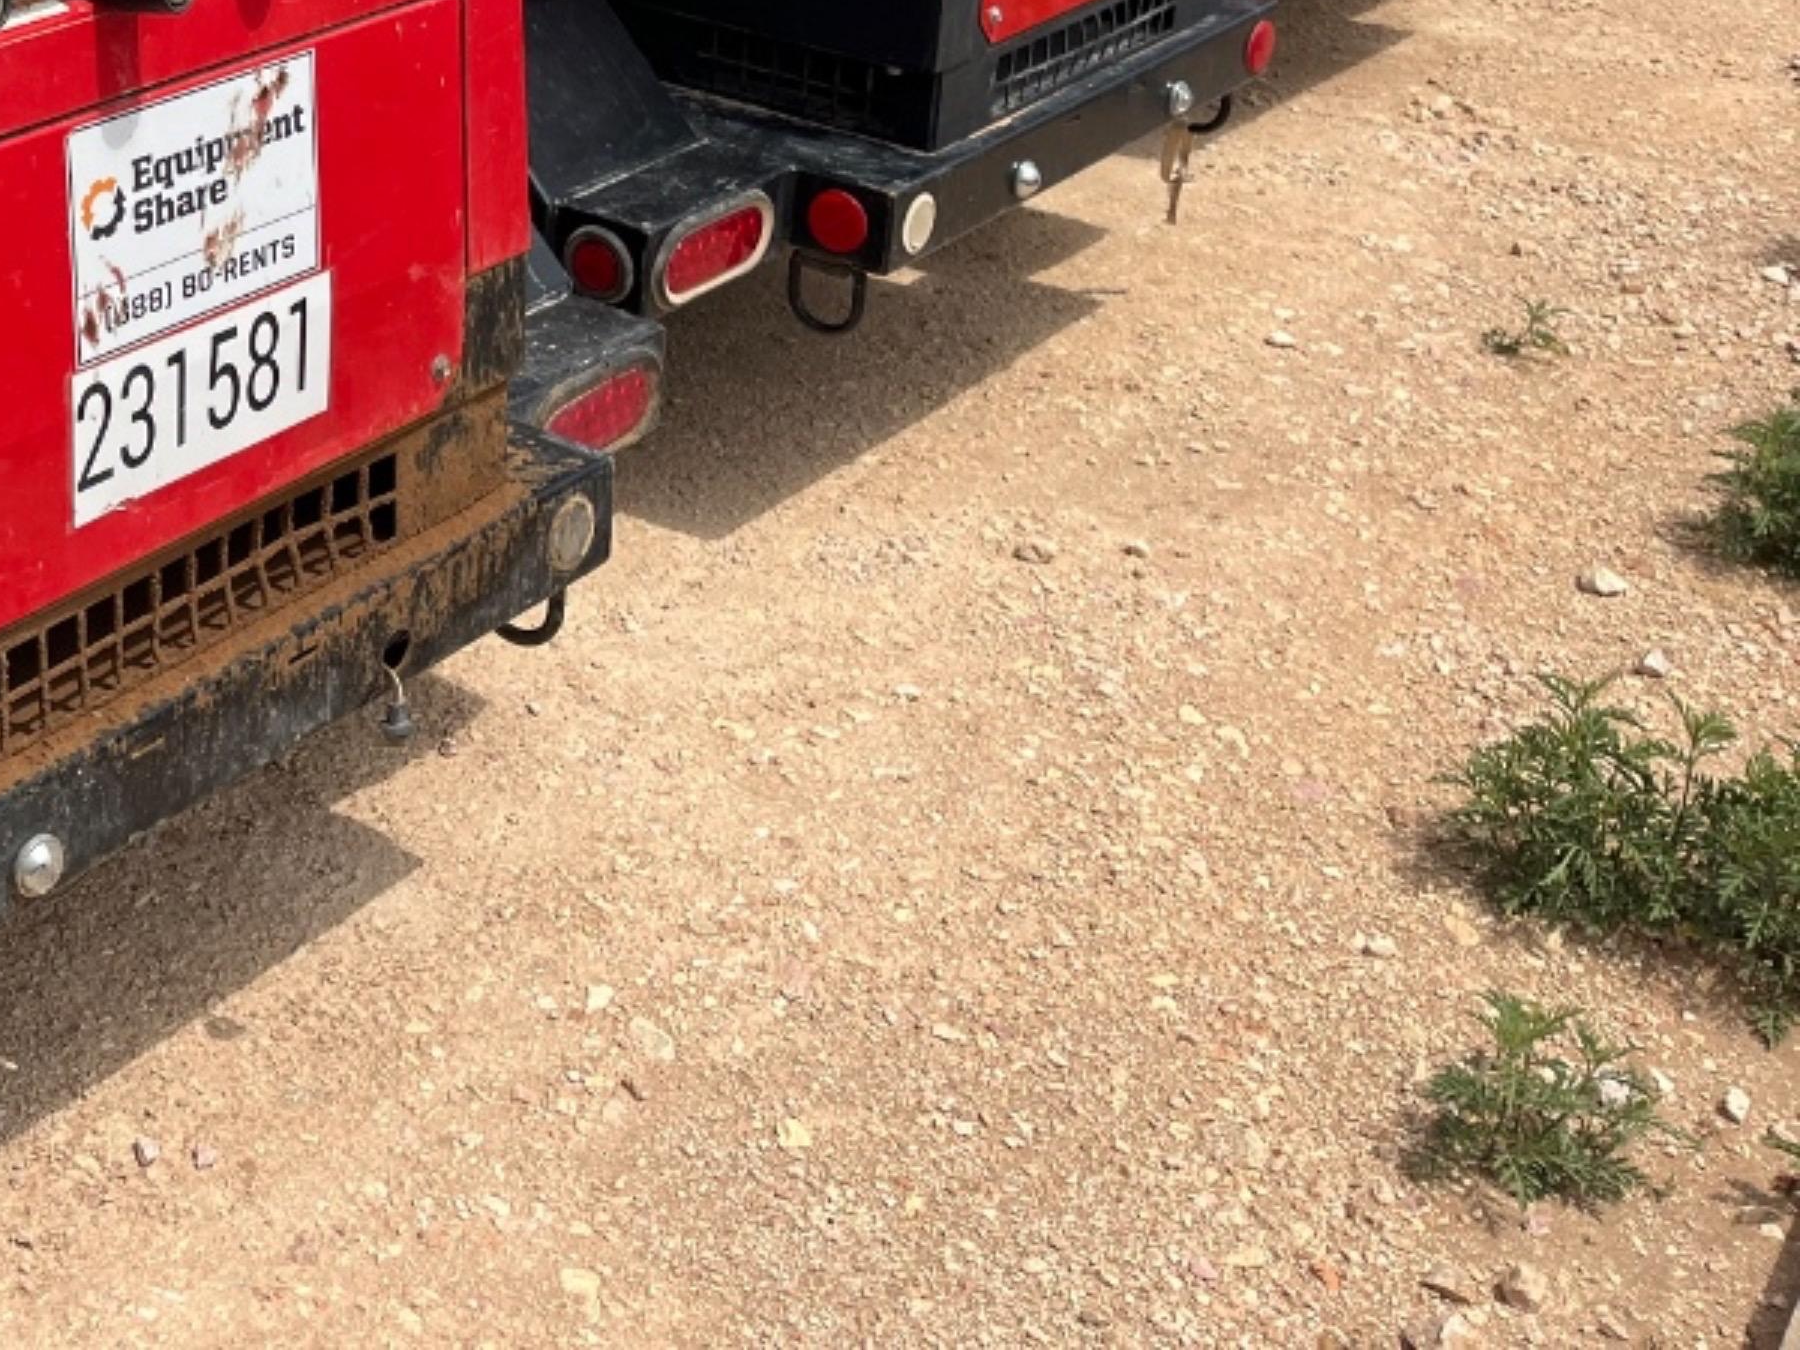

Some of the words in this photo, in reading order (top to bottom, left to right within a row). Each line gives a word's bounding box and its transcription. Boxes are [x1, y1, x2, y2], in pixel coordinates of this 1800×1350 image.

[133, 178, 228, 234] Share
[182, 233, 296, 299] 80-RENTS
[75, 296, 309, 494] 231581
